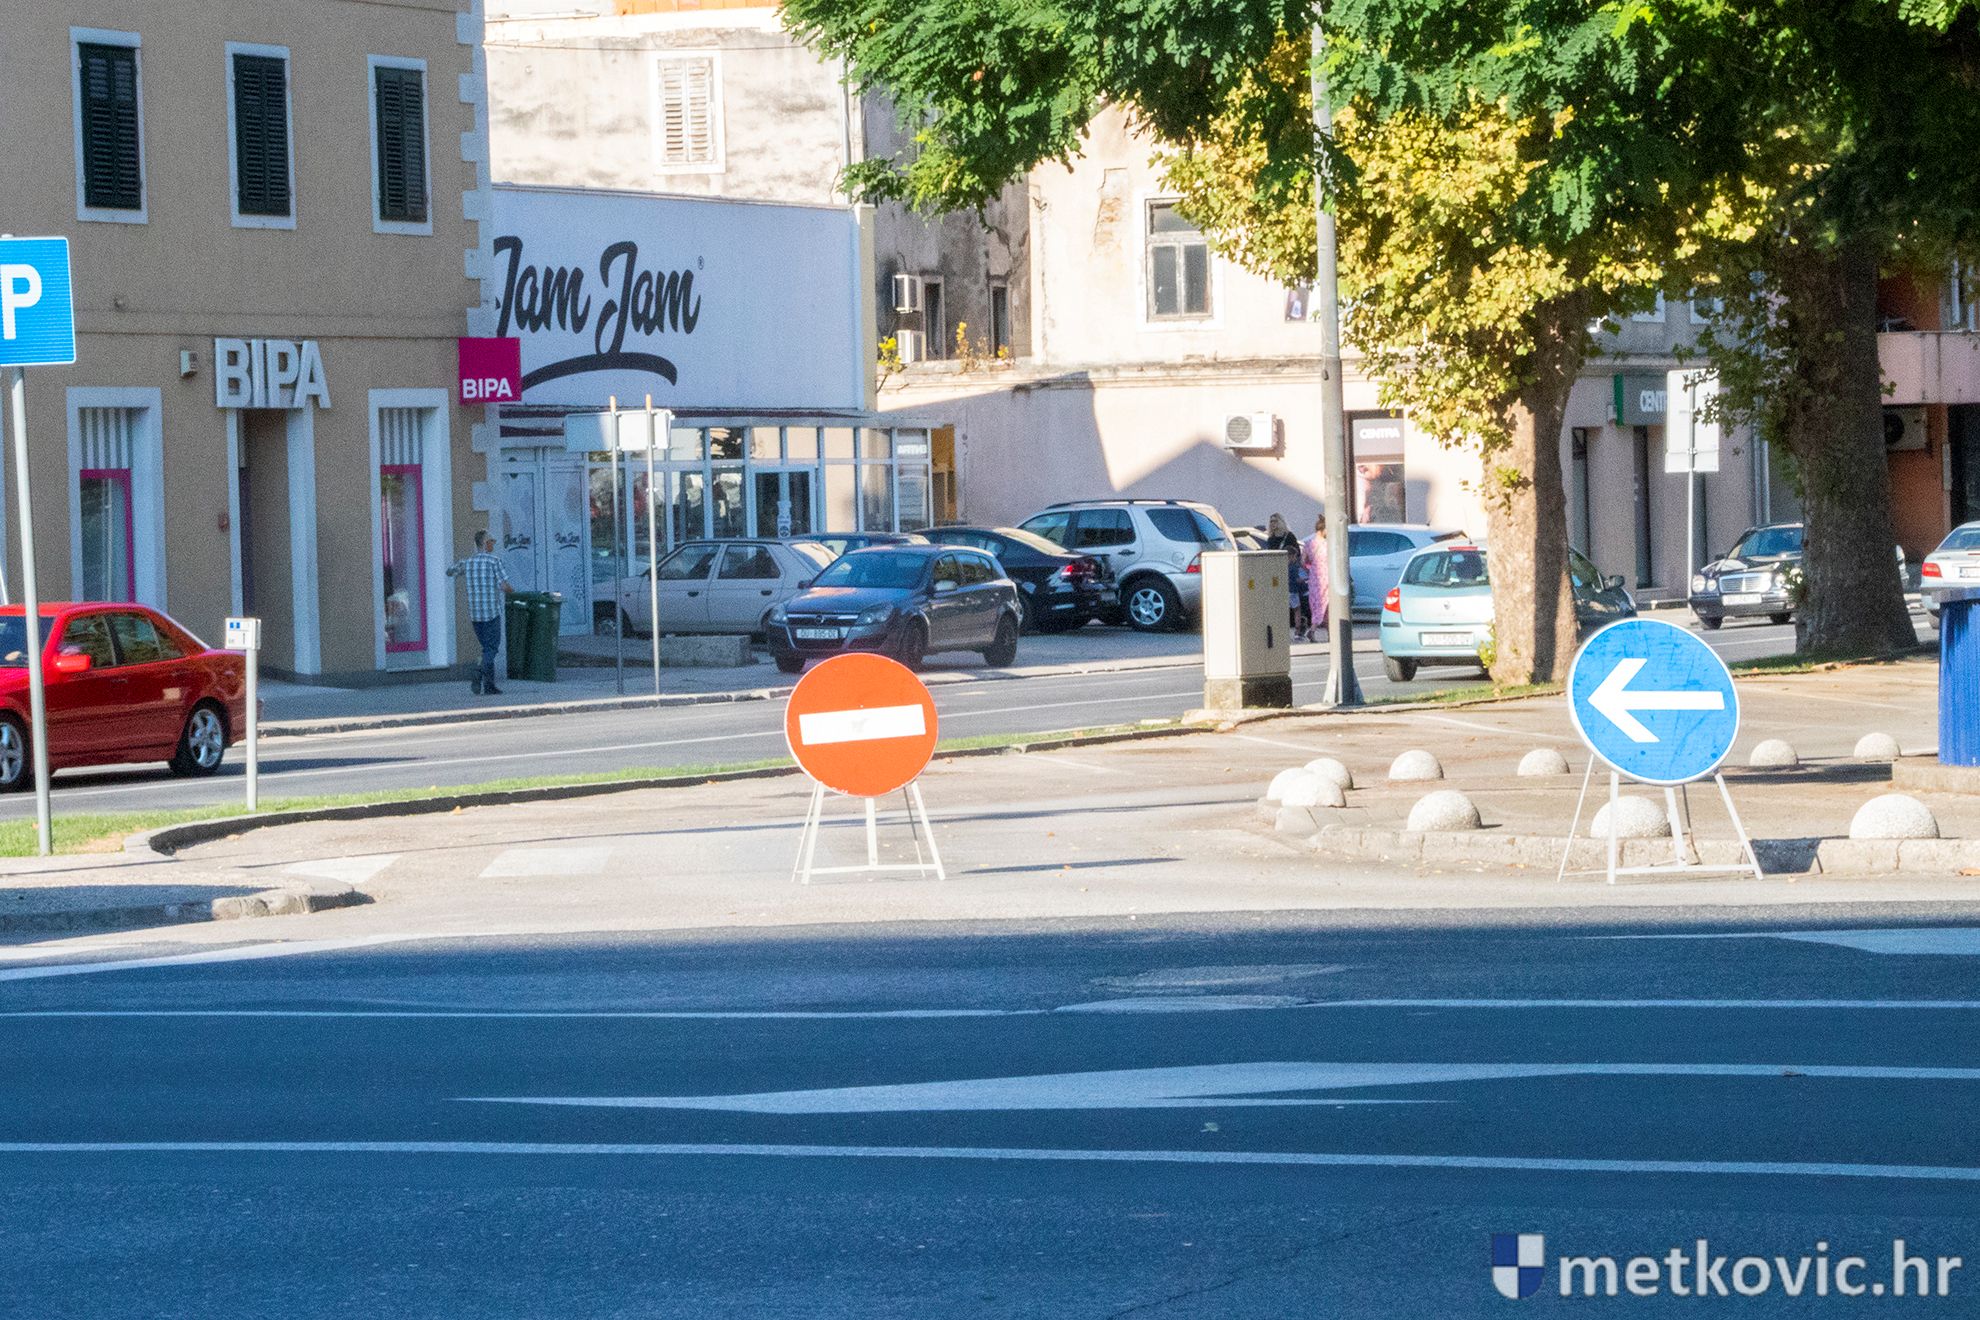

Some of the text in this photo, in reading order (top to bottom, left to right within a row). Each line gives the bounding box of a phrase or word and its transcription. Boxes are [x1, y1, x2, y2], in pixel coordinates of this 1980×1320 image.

[1, 264, 42, 340] P
[595, 241, 700, 354] Jam
[214, 337, 331, 409] BIPA
[462, 378, 512, 398] BIPA
